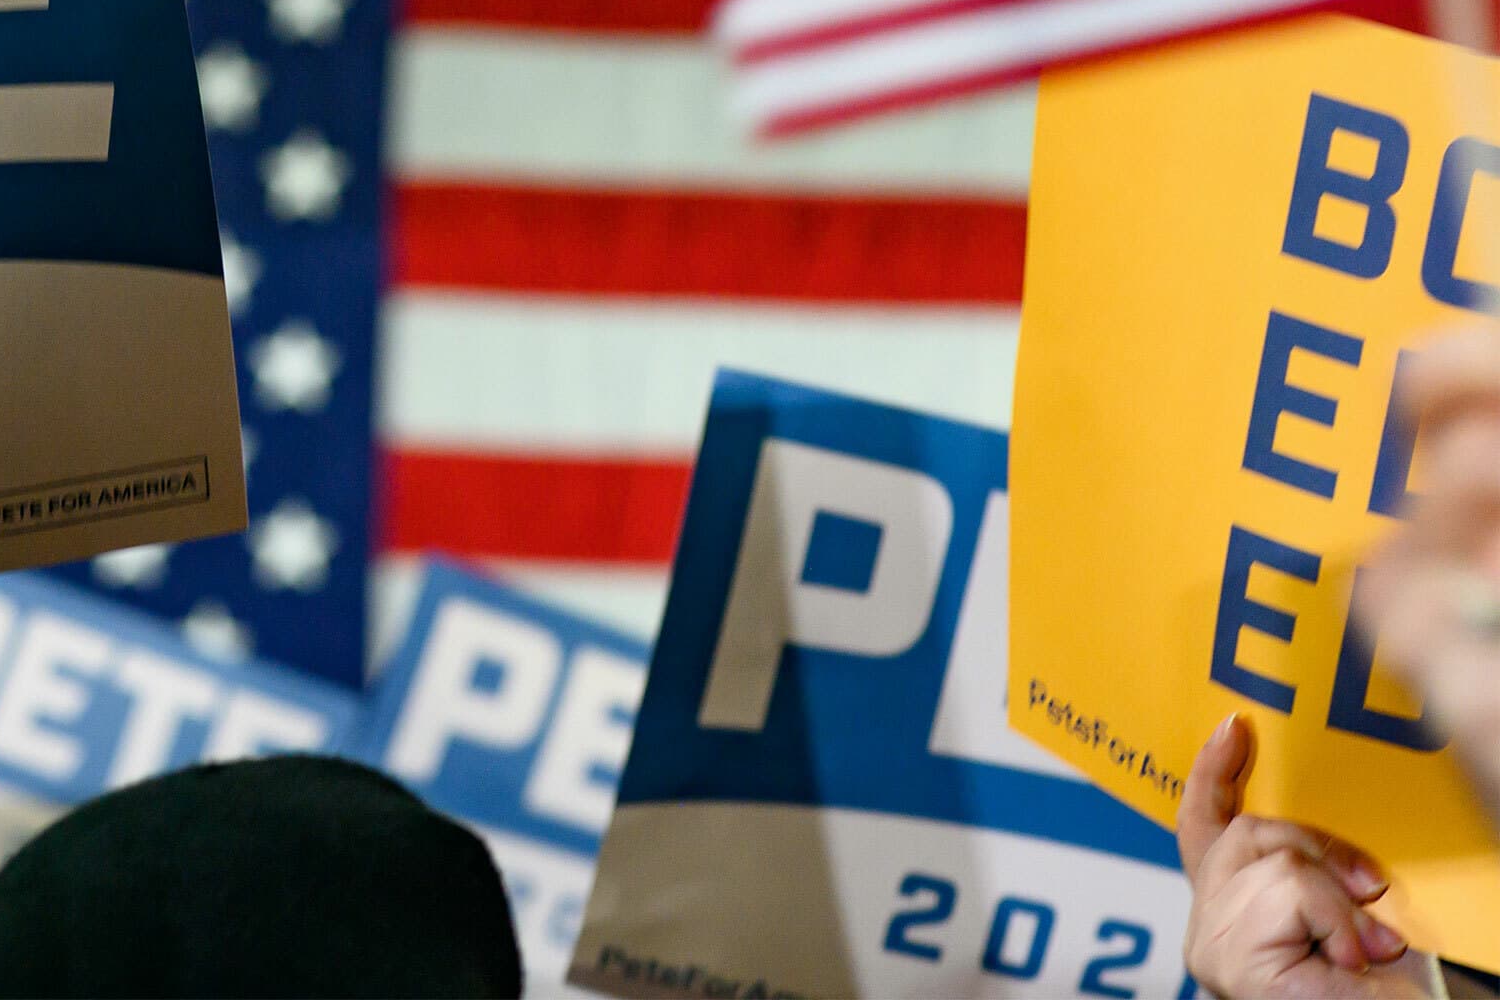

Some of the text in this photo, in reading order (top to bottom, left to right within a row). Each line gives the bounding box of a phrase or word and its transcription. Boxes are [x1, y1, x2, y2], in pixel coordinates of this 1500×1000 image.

[48, 489, 92, 516] FOR
[97, 470, 198, 506] AMERICA
[881, 869, 1200, 1000] 202
